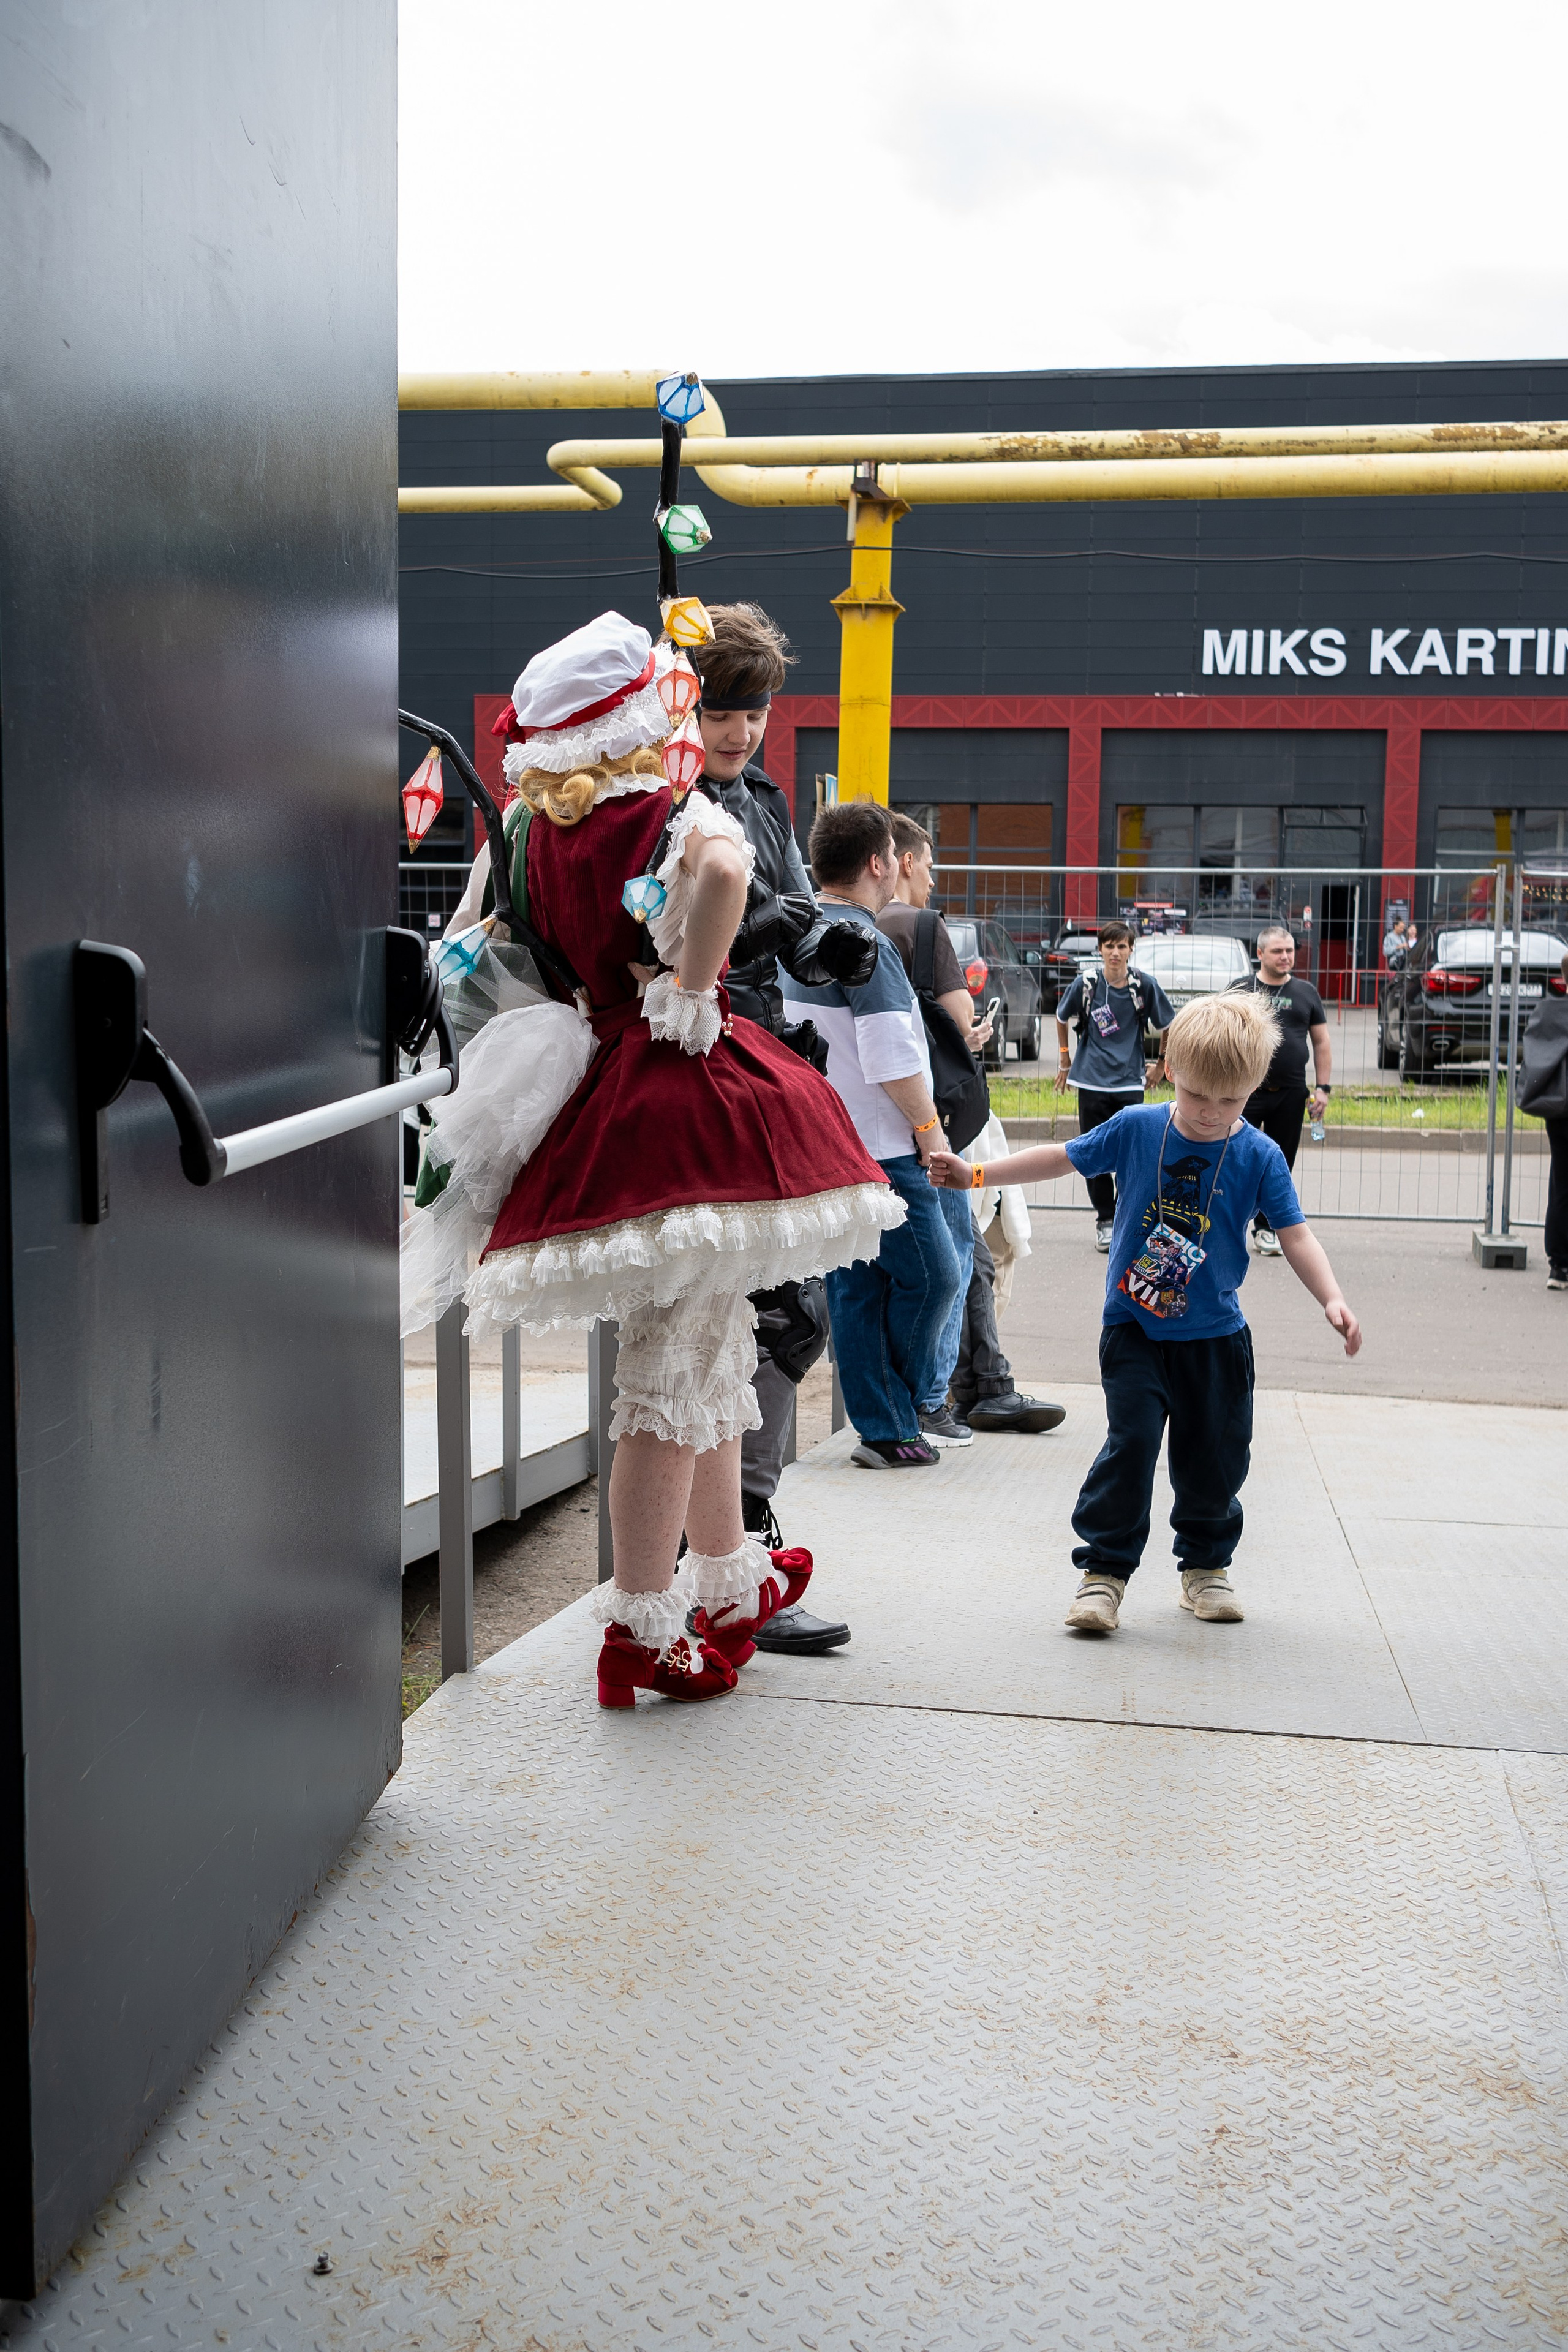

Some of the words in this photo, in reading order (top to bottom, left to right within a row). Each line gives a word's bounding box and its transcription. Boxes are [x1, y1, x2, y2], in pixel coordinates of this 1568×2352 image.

[1202, 628, 1347, 676] MIKS
[1154, 1223, 1205, 1262] EPIC
[1134, 1265, 1147, 1276] RUSSIA
[1142, 1256, 1153, 1265] EPIC
